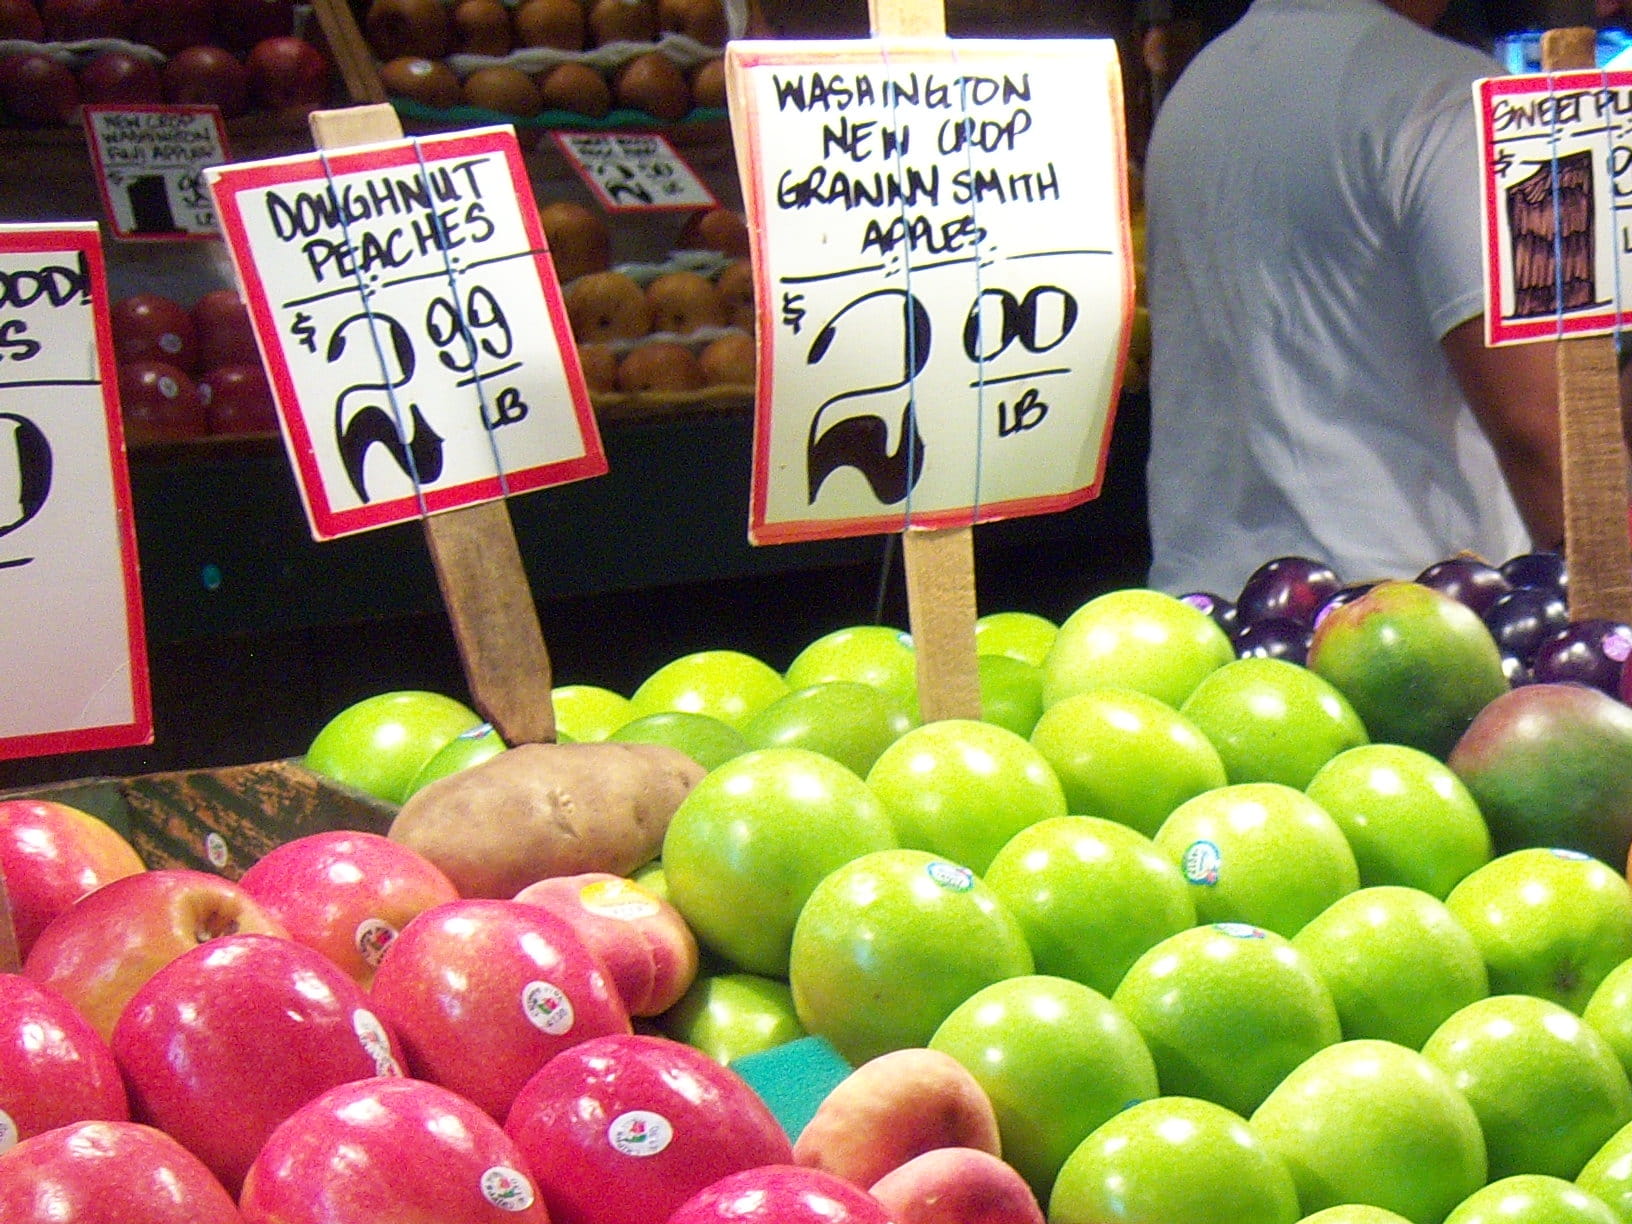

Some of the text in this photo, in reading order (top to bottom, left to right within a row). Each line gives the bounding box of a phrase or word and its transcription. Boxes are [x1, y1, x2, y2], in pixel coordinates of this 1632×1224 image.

[773, 72, 1031, 112] WASHINGTON
[1492, 91, 1587, 131] SWEET
[823, 108, 1032, 160] NEW CROP
[266, 158, 490, 241] DOUGHNUT
[777, 162, 1060, 211] GRANNY SMITH
[302, 202, 495, 282] PEACHES
[861, 216, 987, 255] APPLES
[999, 388, 1049, 437] LB
